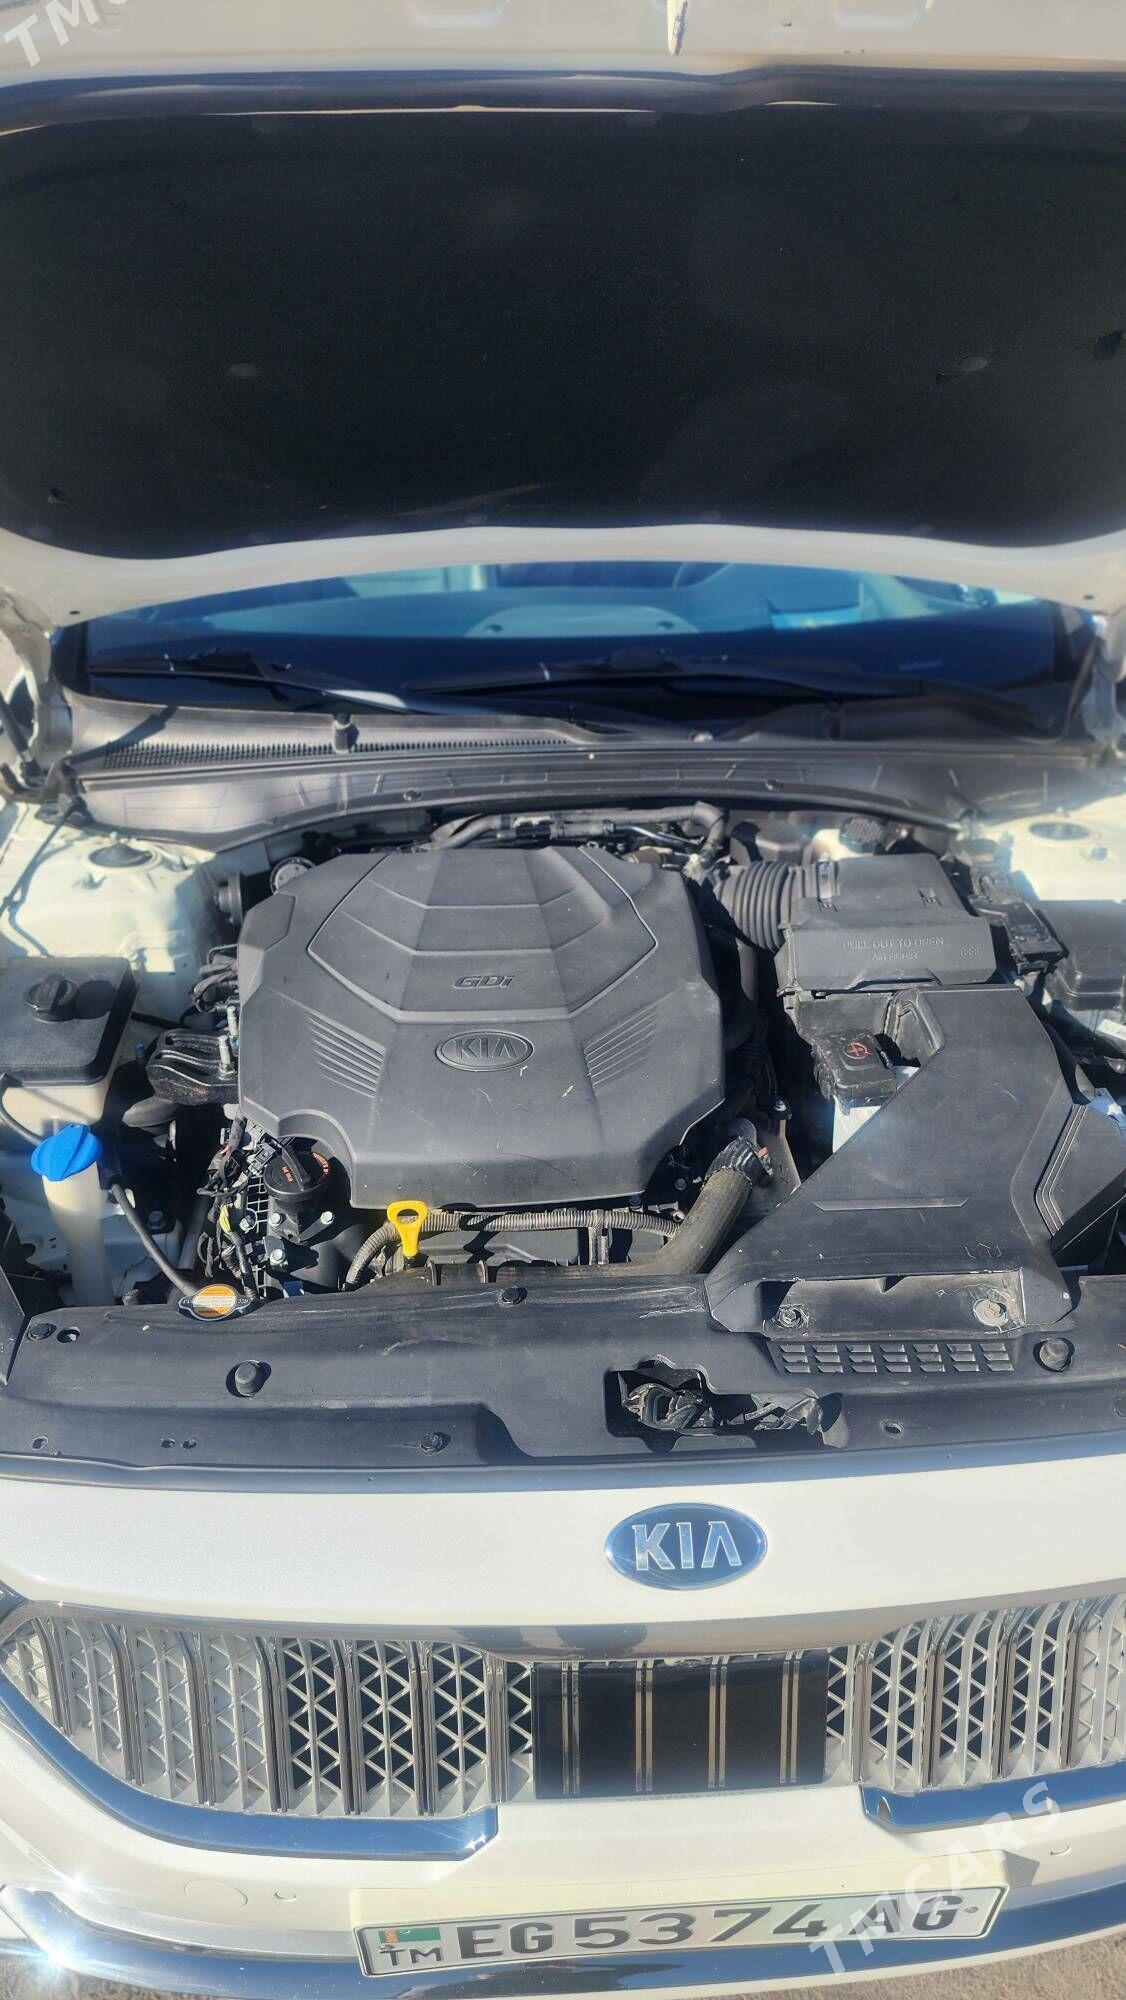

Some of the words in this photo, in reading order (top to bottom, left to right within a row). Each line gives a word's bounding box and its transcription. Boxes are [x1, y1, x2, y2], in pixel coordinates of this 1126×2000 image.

[453, 1037, 518, 1059] KIA
[631, 1520, 743, 1571] KIA
[379, 1947, 443, 1966] TM
